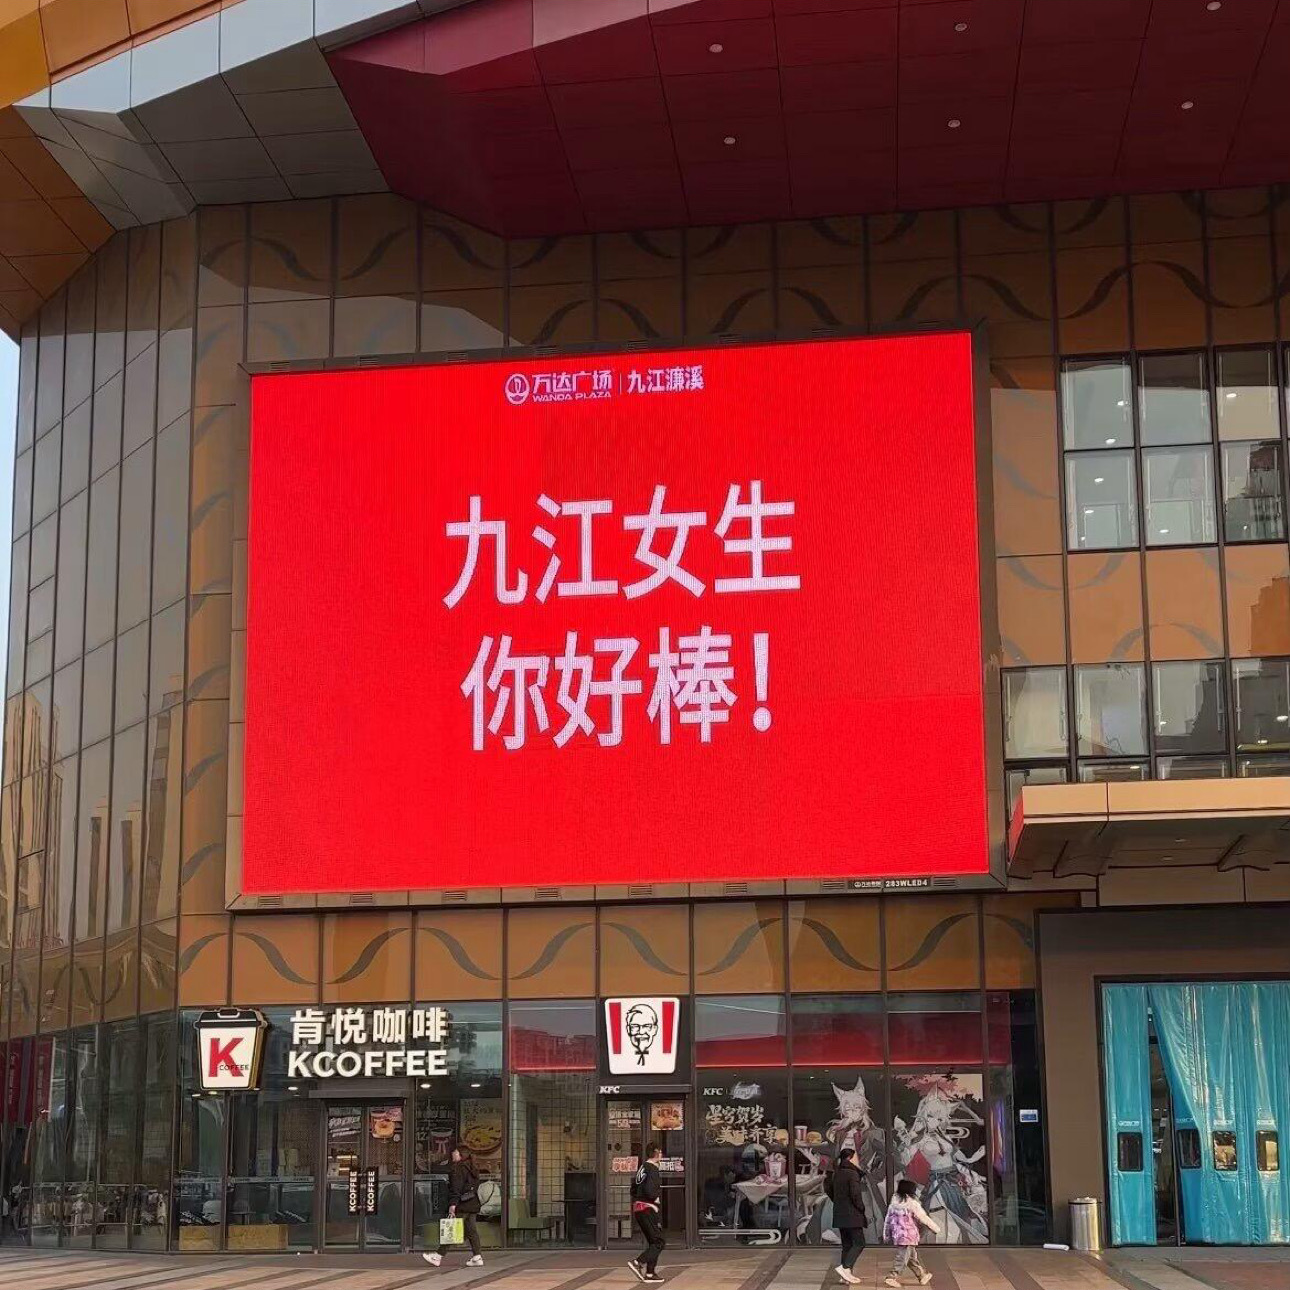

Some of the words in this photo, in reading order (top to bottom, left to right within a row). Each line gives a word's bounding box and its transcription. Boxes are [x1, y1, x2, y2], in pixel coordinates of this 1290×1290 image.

[532, 370, 613, 394] 万达广场
[627, 365, 705, 394] 九江濂溪
[532, 394, 572, 402] WANDA
[575, 391, 612, 400] PLAZA
[442, 479, 801, 610] 九江女生
[459, 624, 773, 751] 你好棒！
[290, 1007, 448, 1045] 肯悦咖啡
[208, 1037, 244, 1077] K
[287, 1049, 448, 1078] KCOFFEE
[600, 1086, 620, 1094] KFC
[703, 1088, 723, 1096] KFC
[349, 1171, 358, 1212] KCOFFEE
[367, 1171, 376, 1212] KCOFFEE
